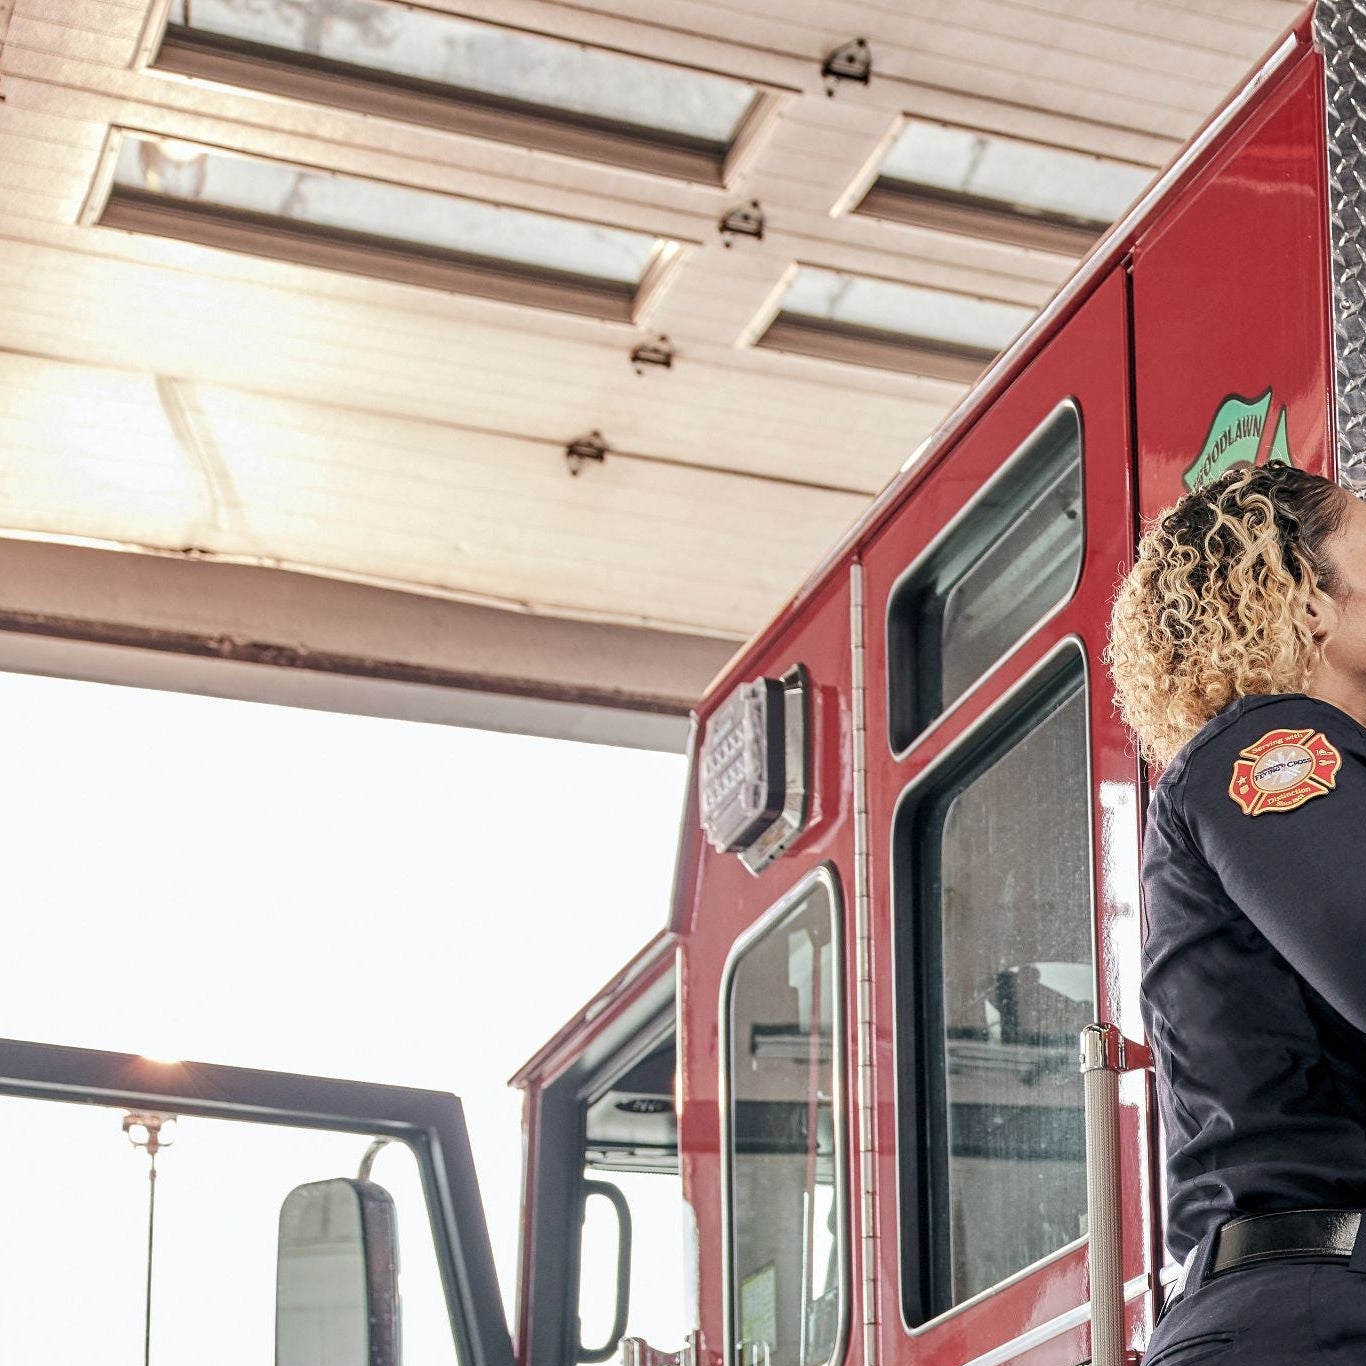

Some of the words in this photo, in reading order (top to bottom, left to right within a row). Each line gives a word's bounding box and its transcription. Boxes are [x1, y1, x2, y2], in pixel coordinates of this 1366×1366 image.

[1252, 738, 1284, 754] Serving
[1286, 757, 1312, 767] CROSS
[1267, 787, 1311, 805] Distinction
